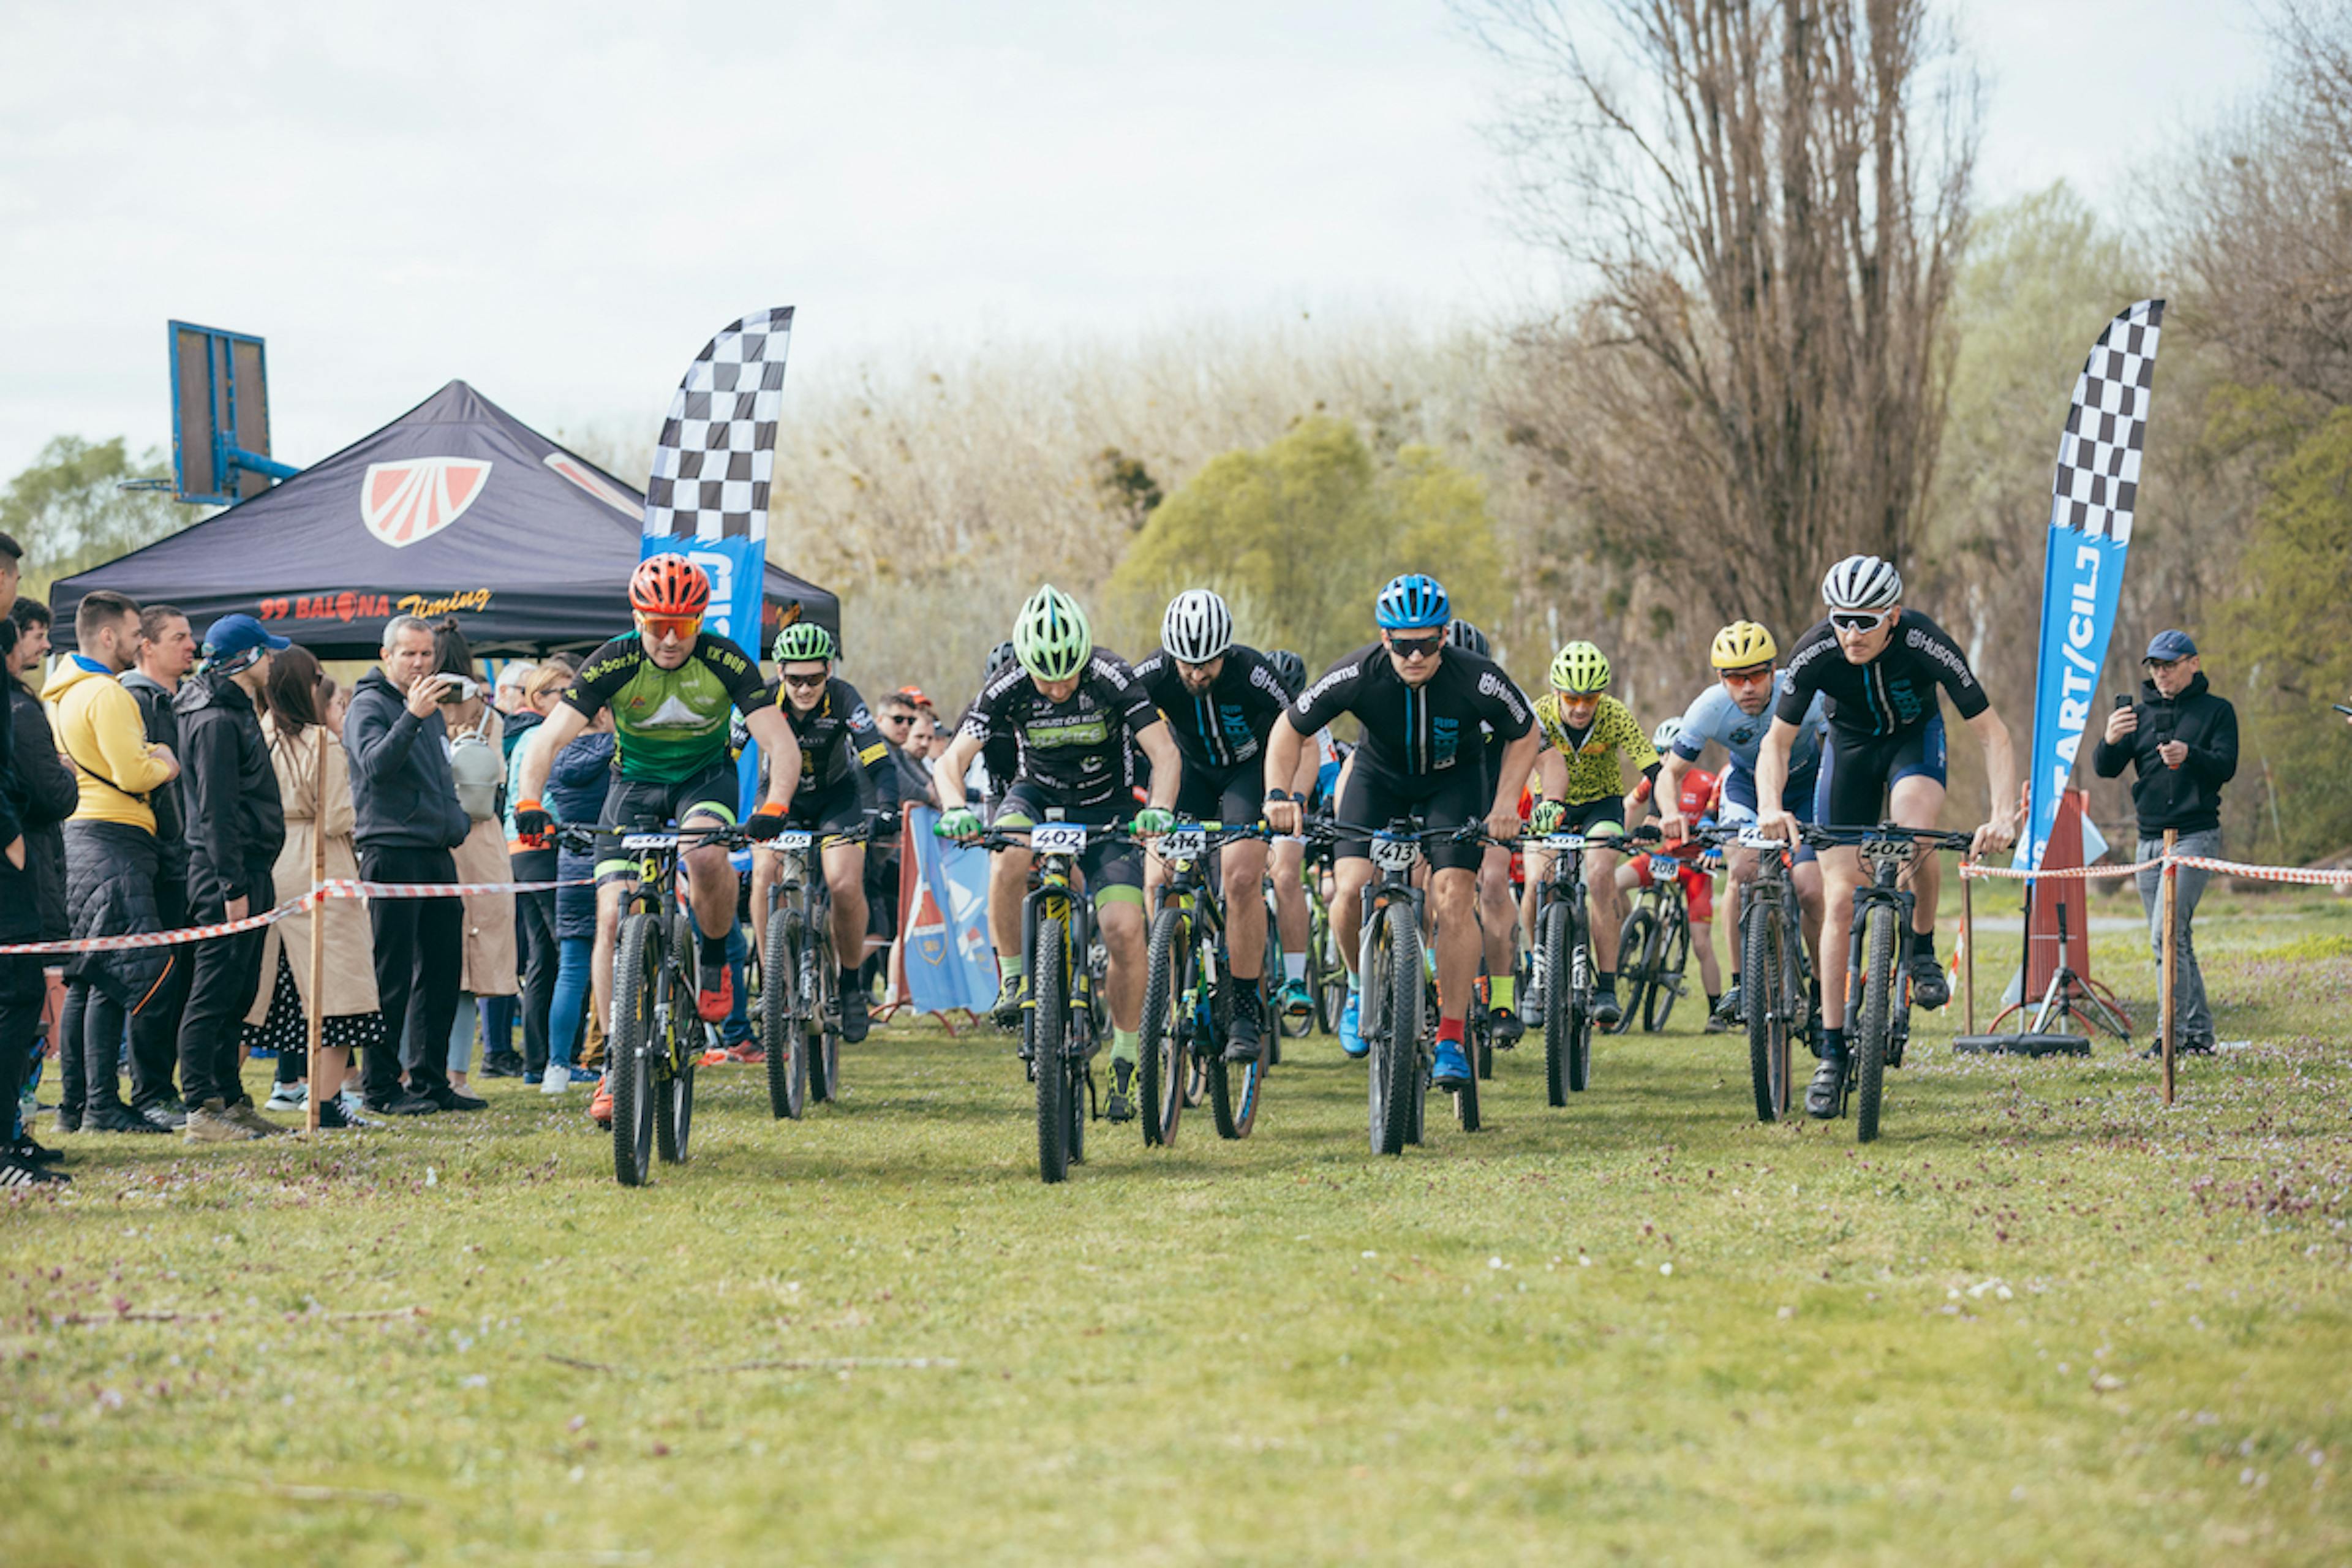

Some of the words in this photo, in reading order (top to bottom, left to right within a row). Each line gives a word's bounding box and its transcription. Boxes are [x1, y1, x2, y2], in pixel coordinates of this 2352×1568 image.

[260, 598, 289, 620] 99
[397, 588, 492, 619] Timing
[1921, 636, 1973, 688] Husqvarna
[1036, 831, 1082, 846] 402
[1374, 841, 1411, 861] 413
[1863, 844, 1912, 858] 404
[1651, 862, 1676, 875] 208
